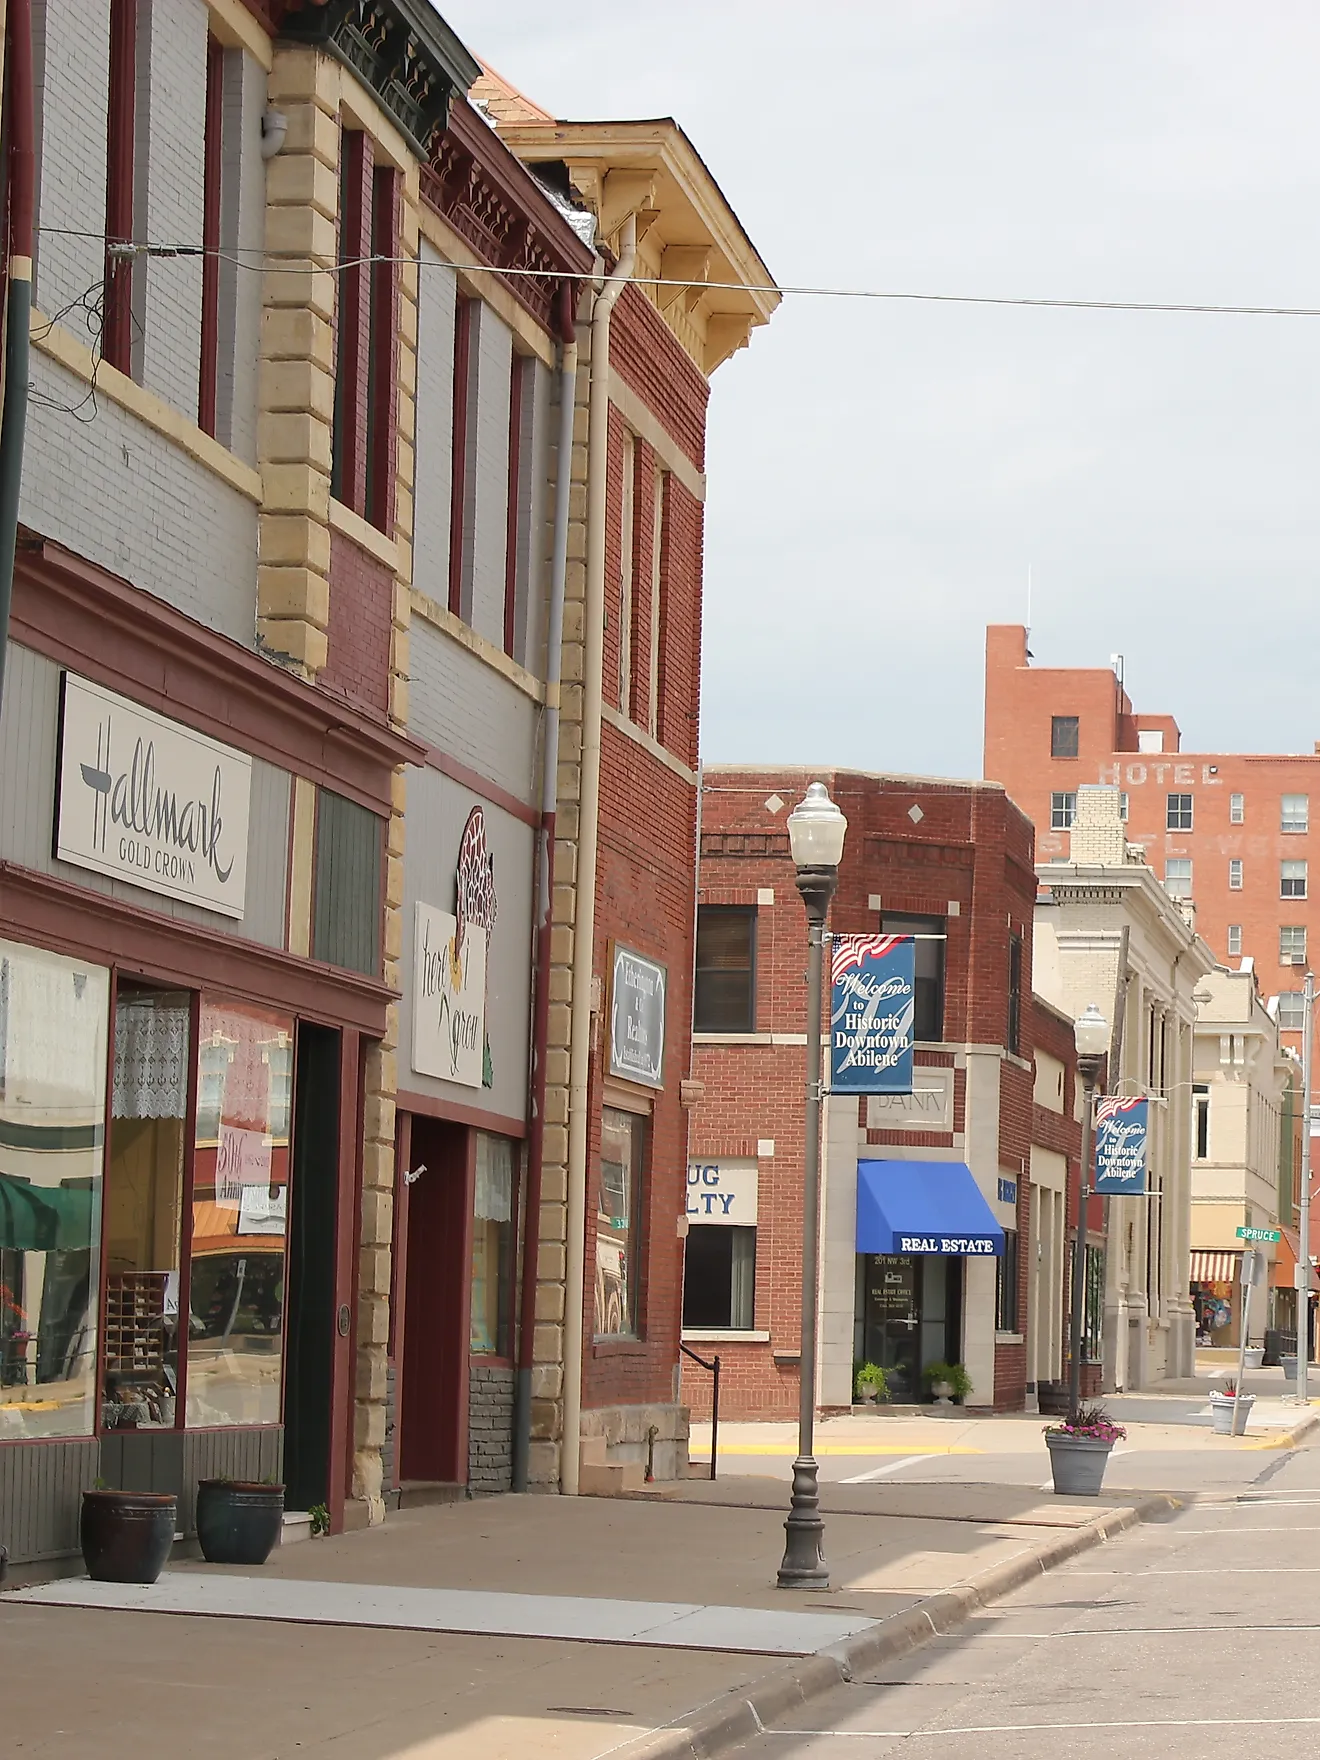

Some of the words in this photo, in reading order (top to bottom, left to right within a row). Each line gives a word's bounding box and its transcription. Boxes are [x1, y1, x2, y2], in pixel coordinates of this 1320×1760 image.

[1099, 762, 1223, 786] HOTEL
[80, 715, 234, 883] Hallmark
[119, 837, 151, 870] GOLD
[155, 850, 195, 884] CROWN
[422, 919, 447, 997] here
[835, 972, 912, 996] Welcome
[853, 1000, 864, 1011] to
[845, 1013, 901, 1031] Historic
[835, 1031, 909, 1049] Downtown
[845, 1049, 898, 1067] Abilene
[1099, 1119, 1145, 1135] Welcome
[1104, 1145, 1138, 1156] Historic
[1098, 1155, 1143, 1168] Downtown
[1104, 1167, 1137, 1179] Abilene
[1241, 1229, 1275, 1241] SPRUCE
[901, 1237, 938, 1252] REAL
[941, 1239, 994, 1253] ESTATE
[874, 1255, 886, 1265] 201
[887, 1257, 898, 1265] NW
[900, 1257, 911, 1266] 3rd
